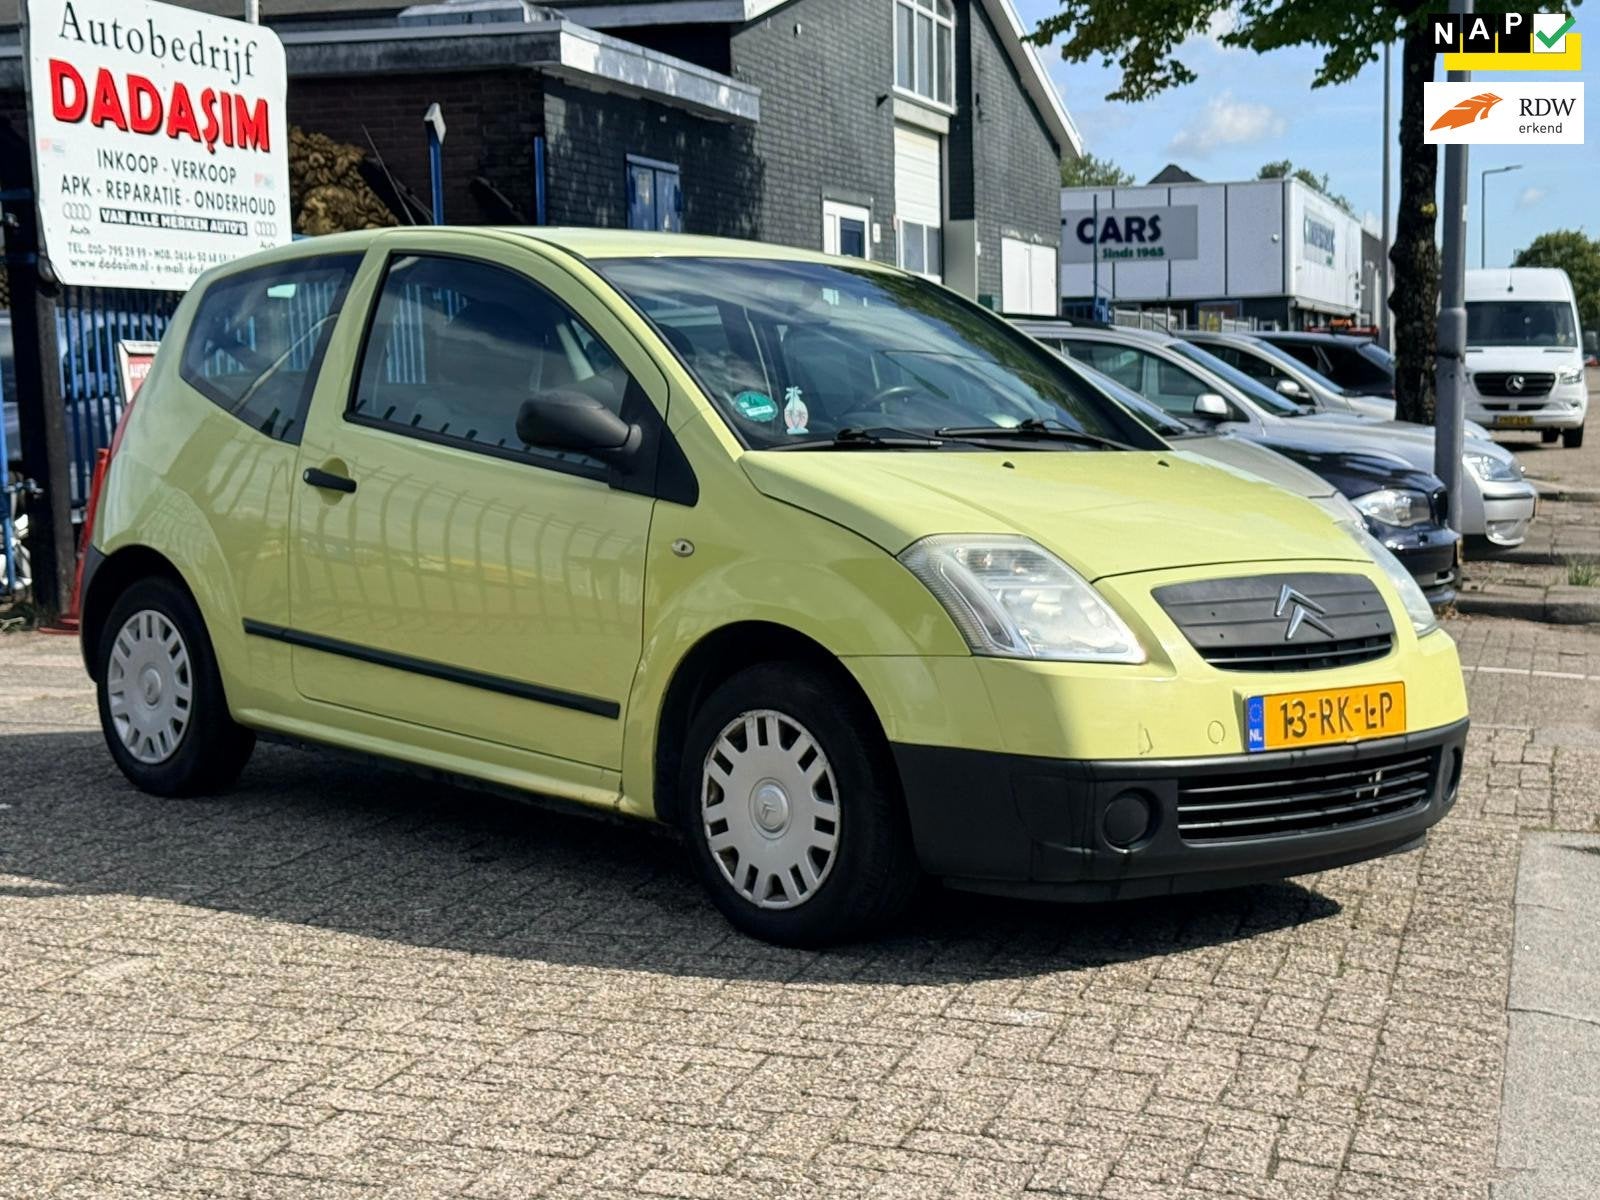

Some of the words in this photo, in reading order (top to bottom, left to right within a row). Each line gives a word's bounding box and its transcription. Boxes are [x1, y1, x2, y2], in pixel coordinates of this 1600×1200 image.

[58, 1, 258, 86] Autobedrijf
[48, 58, 271, 155] DADAŞIM
[97, 148, 158, 175] INKOOP
[171, 158, 237, 184] VERKOOP
[61, 174, 92, 197] APK
[106, 179, 181, 206] REPARATIE
[194, 190, 276, 216] ONDERHOUD
[101, 208, 127, 224] VAN
[129, 211, 159, 227] ALLE
[160, 214, 208, 231] MERKEN
[209, 219, 246, 235] AUTO'S
[1076, 213, 1162, 245] CARS
[1249, 728, 1263, 742] NL
[1280, 692, 1393, 740] 13-RK-LP
